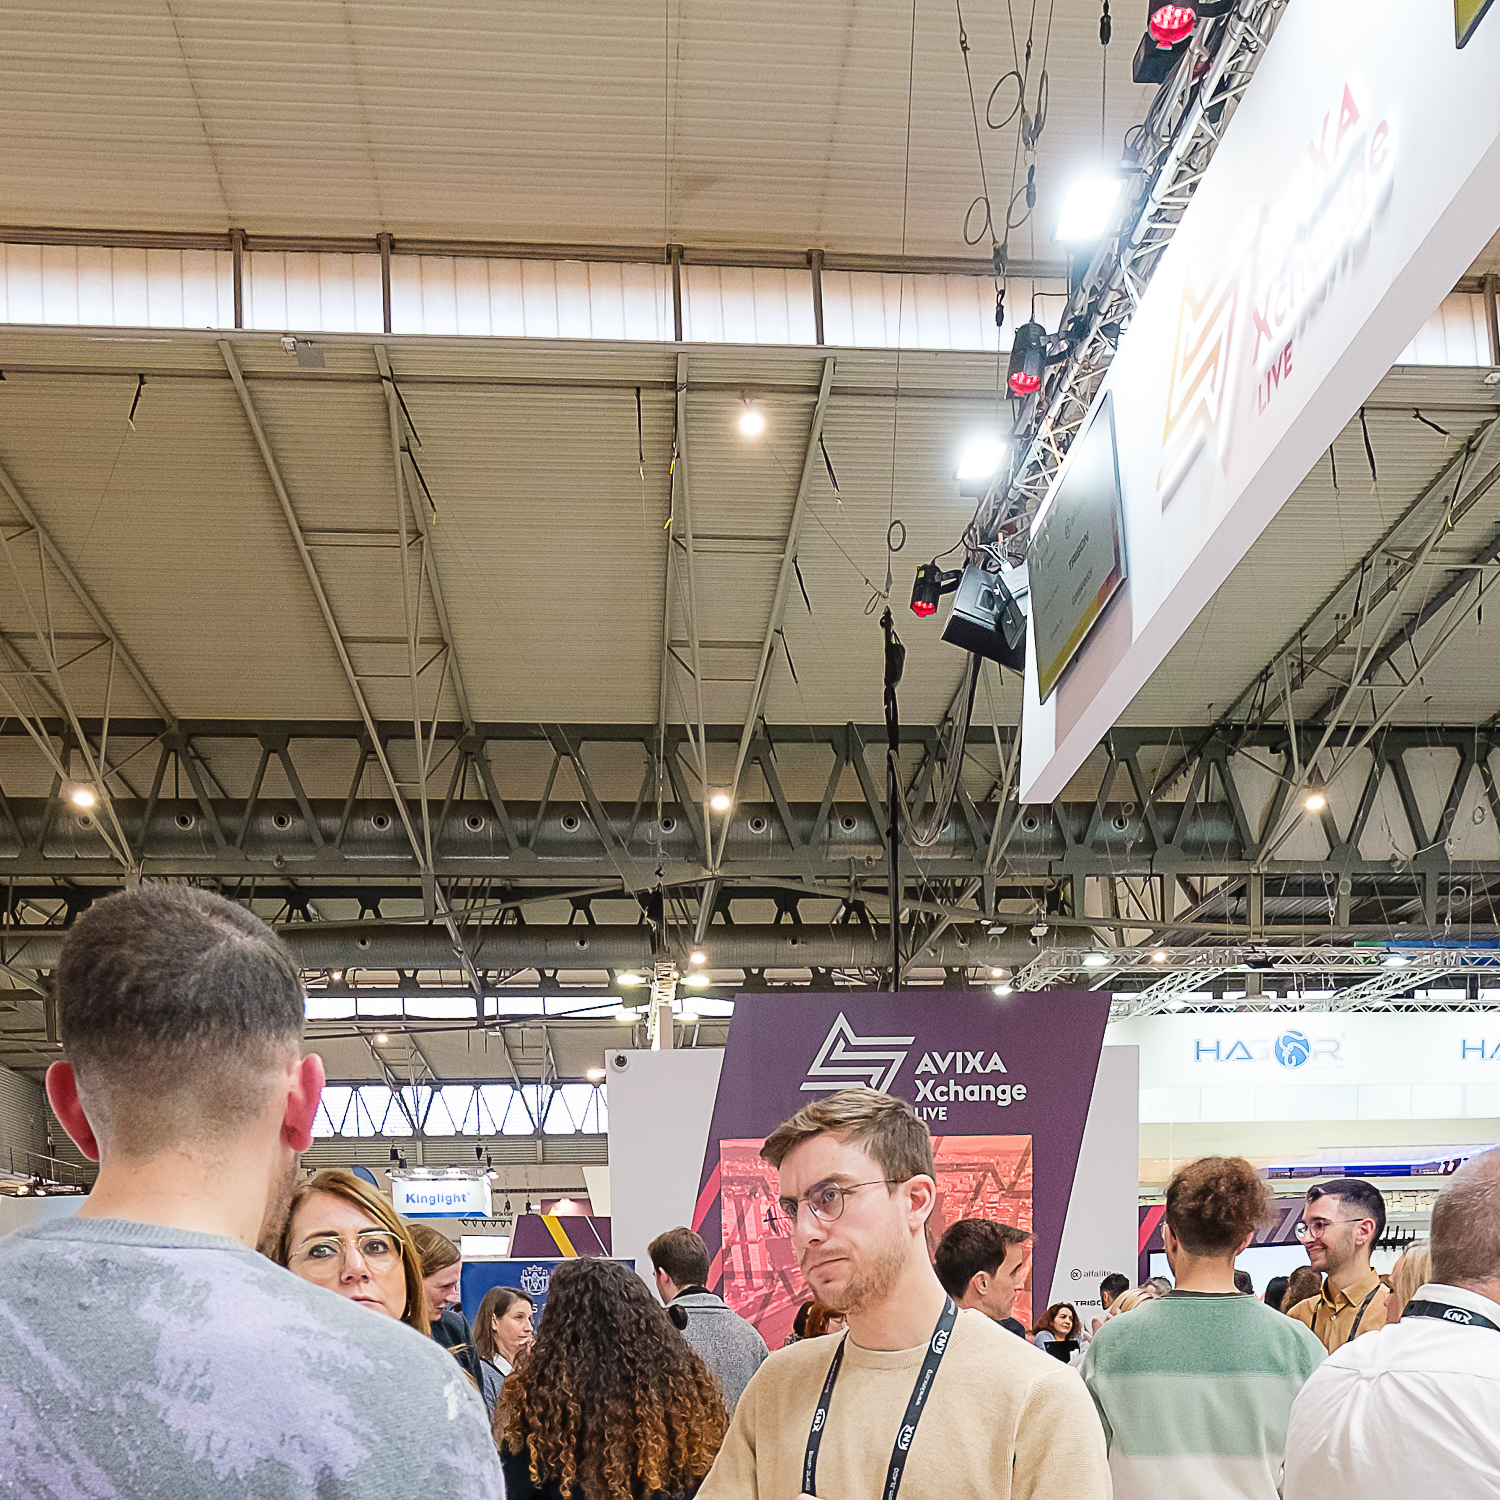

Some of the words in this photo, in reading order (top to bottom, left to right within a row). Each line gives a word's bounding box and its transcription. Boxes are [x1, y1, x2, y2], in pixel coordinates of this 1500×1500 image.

[1258, 337, 1293, 417] LIVE
[914, 1051, 1008, 1075] AVIXA
[914, 1079, 1027, 1107] Xchange
[914, 1106, 948, 1121] LIVE
[406, 1193, 467, 1205] Kinglight
[1443, 1310, 1472, 1325] KNX
[933, 1330, 949, 1354] KNX
[812, 1408, 826, 1432] KNX
[898, 1424, 914, 1450] KNX
